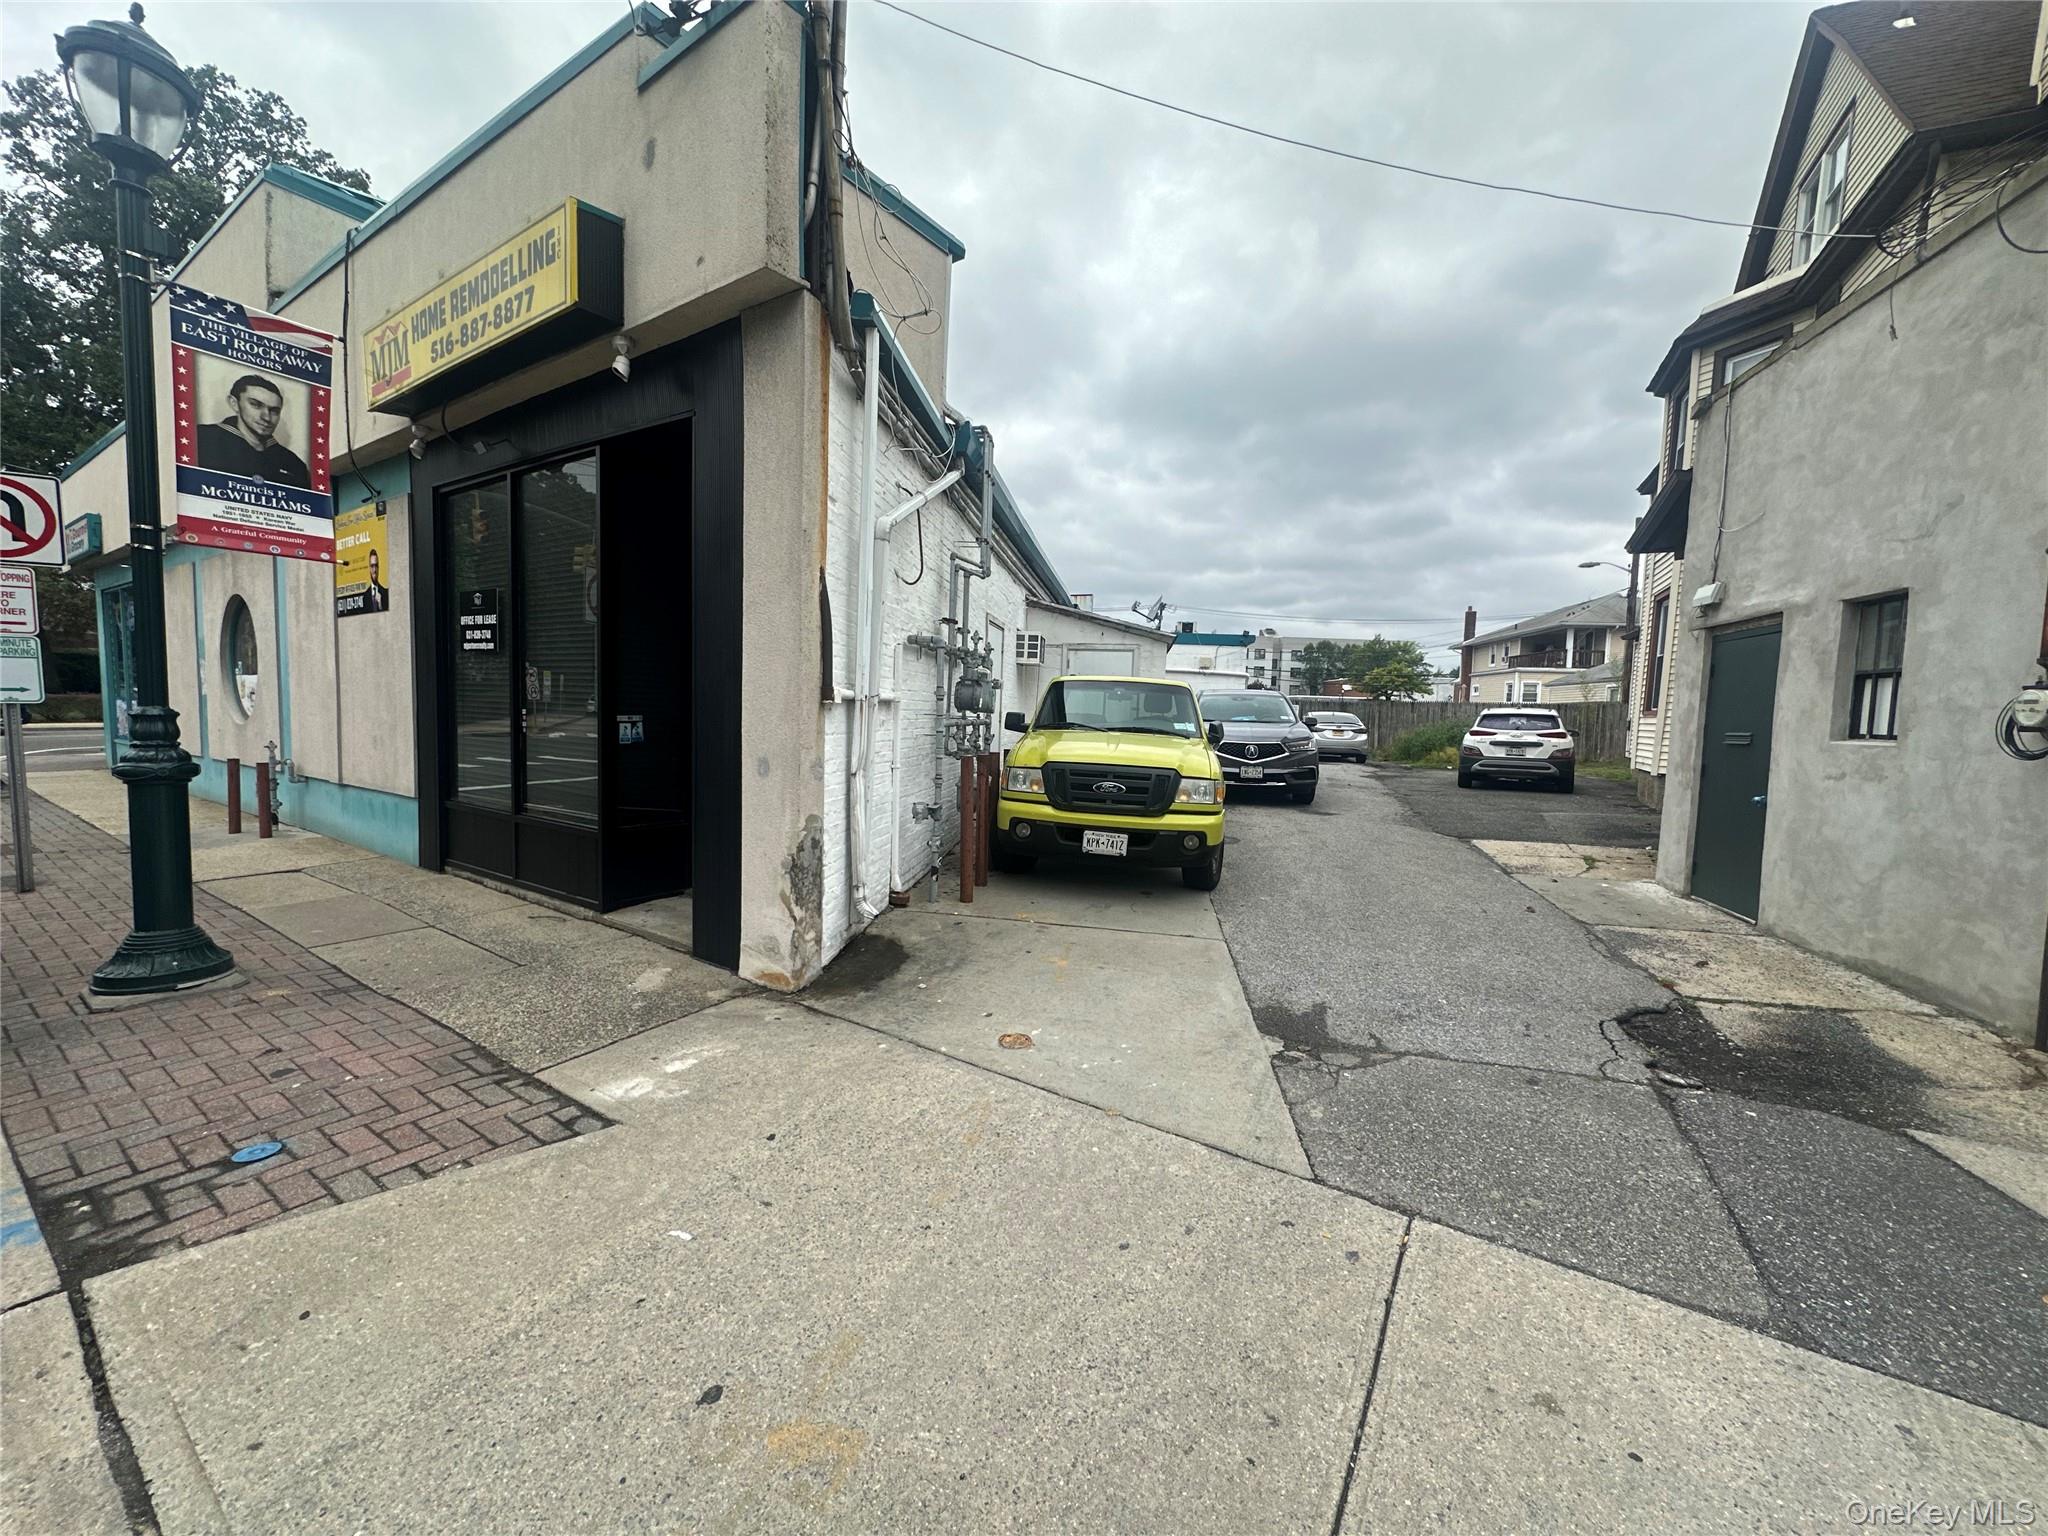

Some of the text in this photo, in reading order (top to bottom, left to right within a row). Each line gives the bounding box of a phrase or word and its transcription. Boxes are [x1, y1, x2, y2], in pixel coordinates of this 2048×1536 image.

[411, 227, 557, 345] HOME REMODELLING
[430, 285, 536, 364] 516-887-8877
[200, 318, 309, 358] THE VILLAGE OF
[180, 321, 322, 374] EAST ROCKAWAY
[227, 348, 283, 371] HONORS
[370, 330, 410, 386] MJM
[227, 481, 274, 496] Francis
[213, 513, 238, 522] National
[240, 518, 263, 526] Defense
[265, 521, 286, 529] Service
[224, 505, 293, 521] UNITED STATES NAVY
[264, 517, 284, 525] Korean
[221, 526, 257, 537] Grateful
[259, 533, 307, 545] Community
[355, 531, 371, 545] CALL
[0, 572, 31, 583] OPPING
[1, 591, 16, 599] RE
[1, 599, 10, 607] O
[460, 614, 497, 625] OFFICE FOR LEASE
